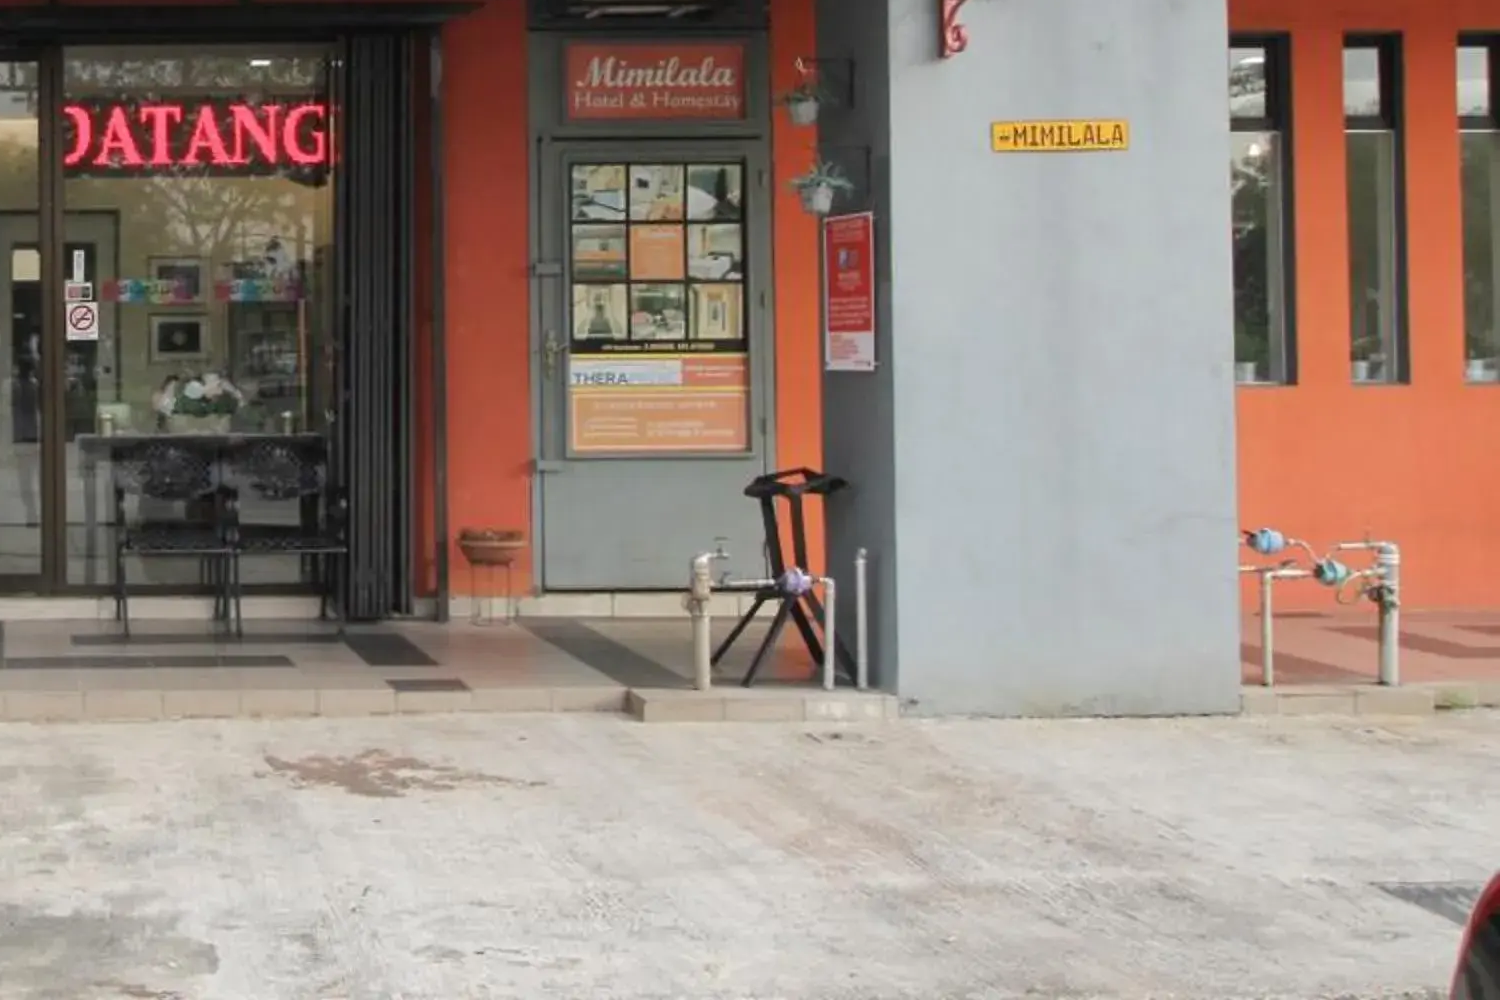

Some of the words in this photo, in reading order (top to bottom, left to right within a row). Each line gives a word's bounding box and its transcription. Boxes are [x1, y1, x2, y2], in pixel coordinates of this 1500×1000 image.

[576, 55, 735, 87] Mimilala
[574, 91, 624, 110] Hotel
[630, 92, 647, 109] &
[652, 91, 740, 110] Homestay
